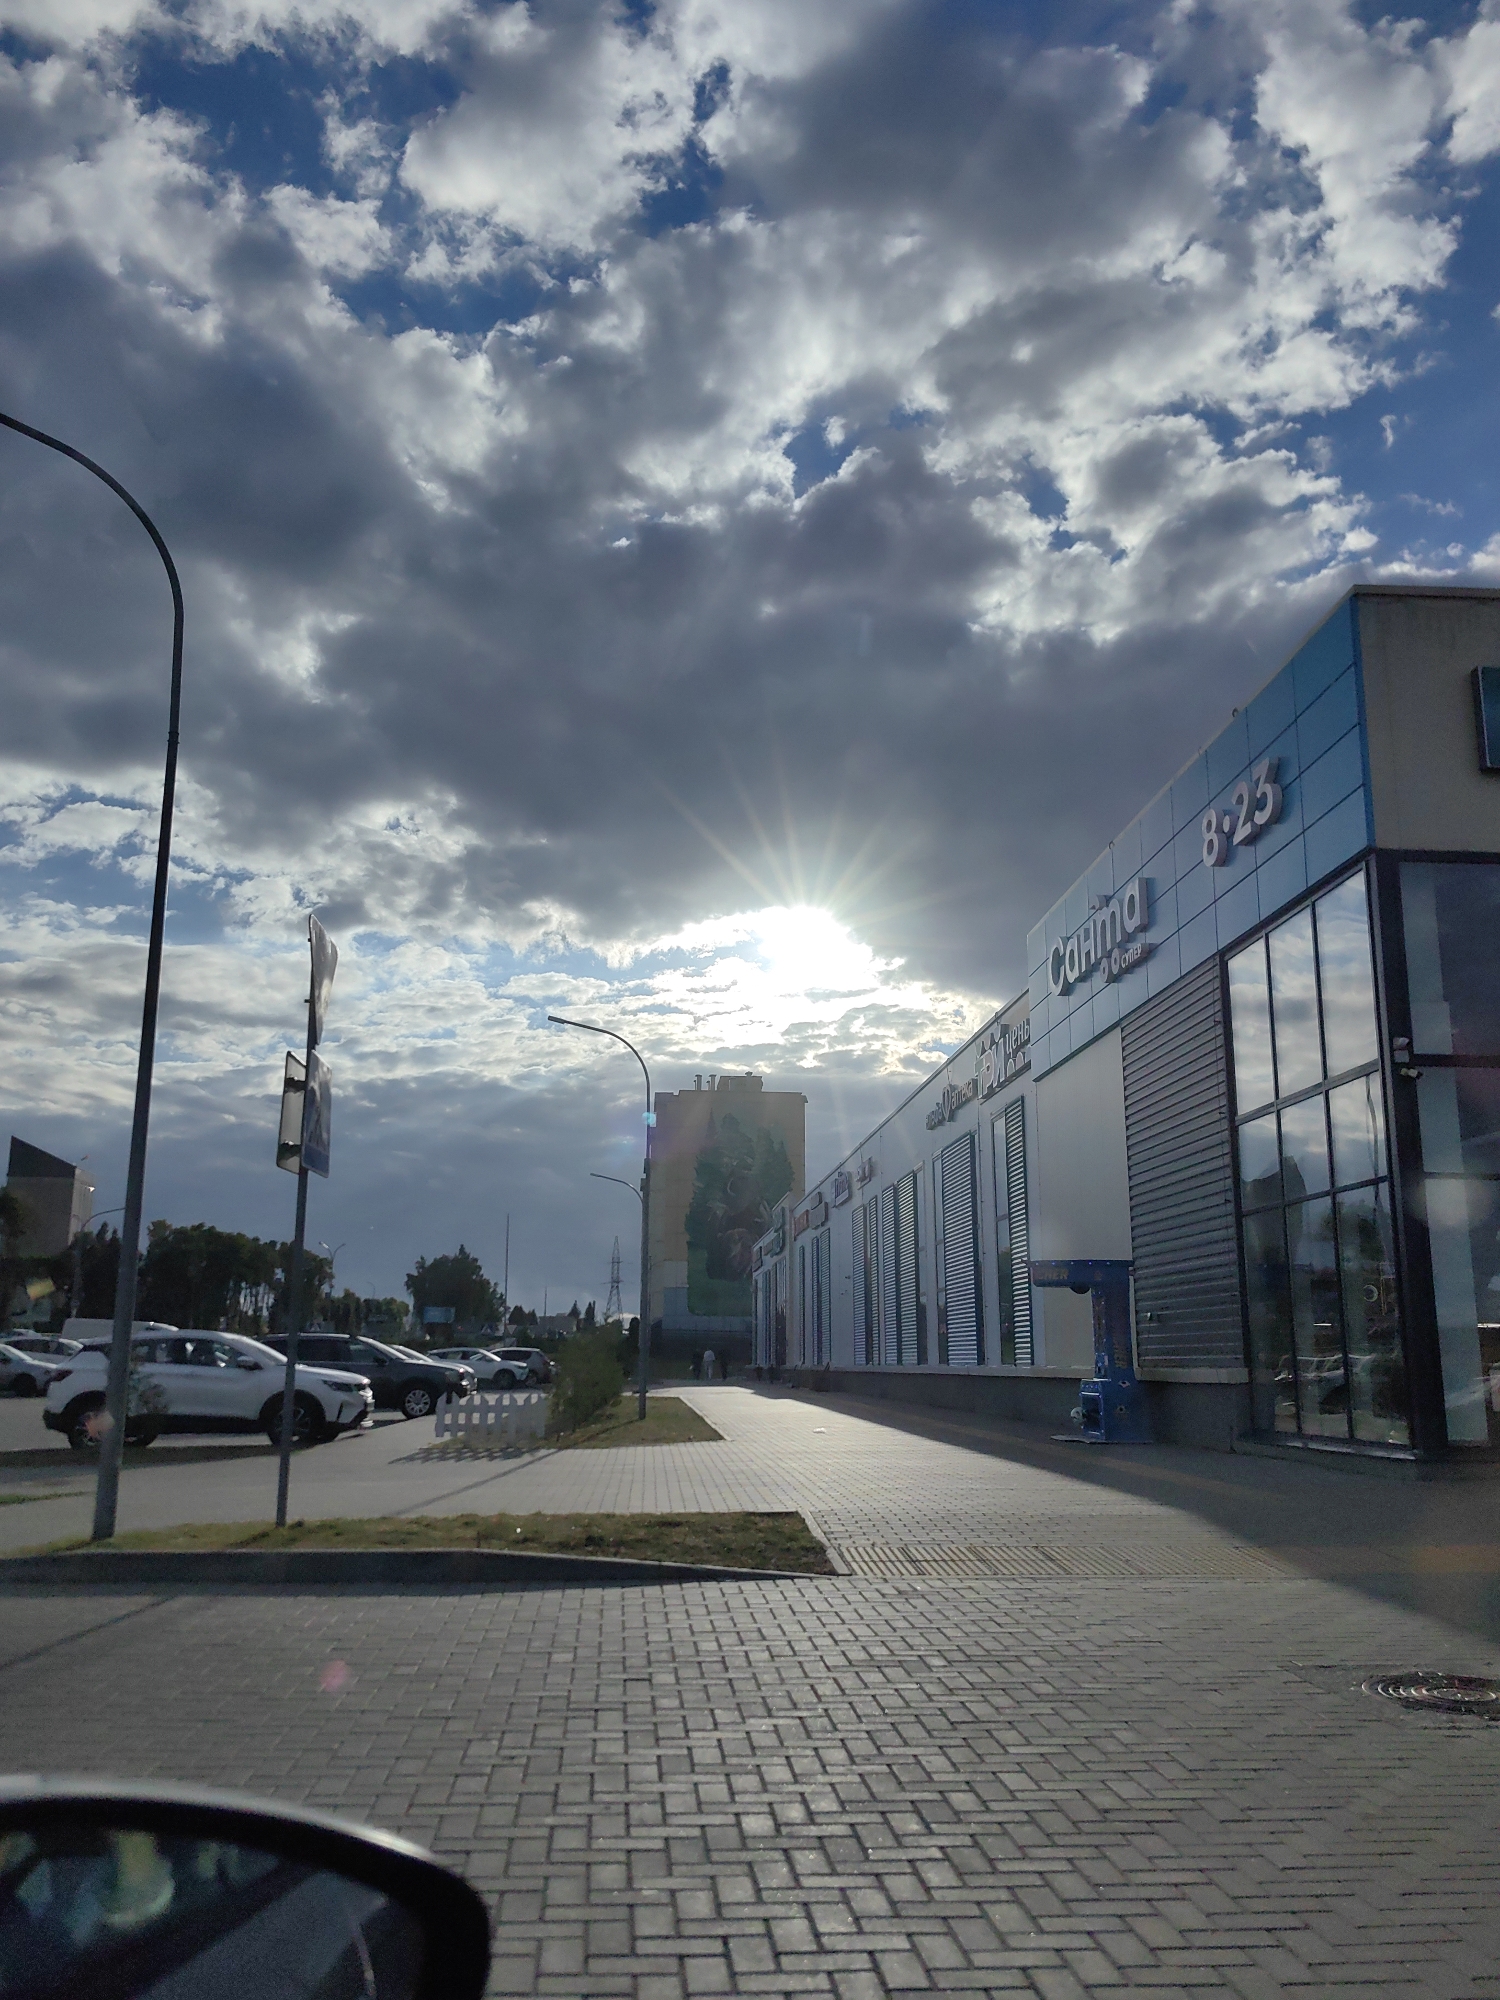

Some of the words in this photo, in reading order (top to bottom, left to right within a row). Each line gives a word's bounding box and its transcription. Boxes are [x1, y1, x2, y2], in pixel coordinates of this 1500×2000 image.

[1049, 877, 1145, 996] Санта
[1121, 943, 1142, 969] СУПЕР
[951, 1080, 973, 1110] аптека
